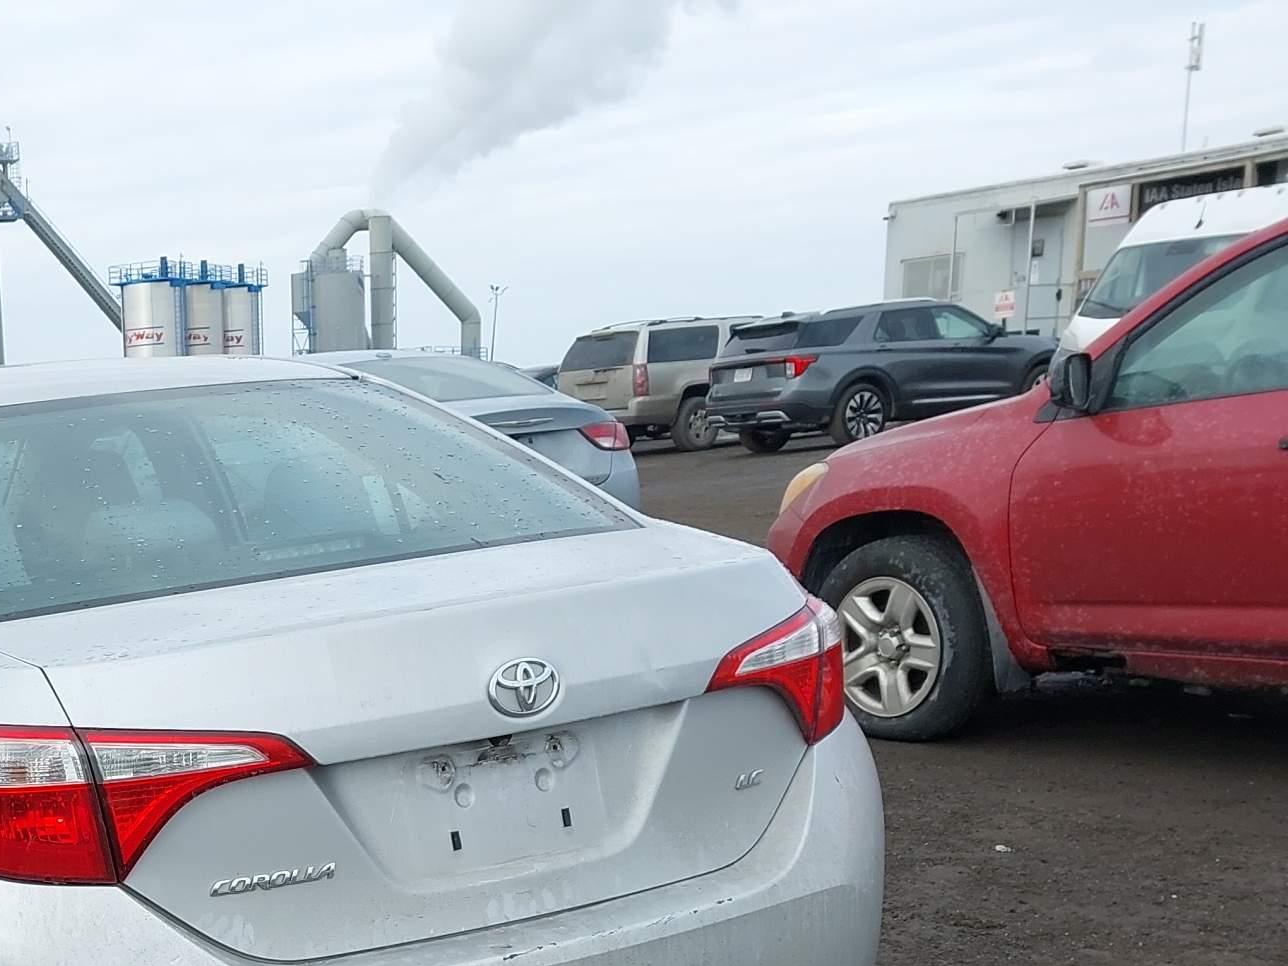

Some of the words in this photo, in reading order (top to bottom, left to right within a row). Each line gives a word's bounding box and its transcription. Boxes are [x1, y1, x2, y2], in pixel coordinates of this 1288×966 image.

[1216, 175, 1243, 191] Isla
[735, 769, 764, 790] LE
[210, 862, 336, 897] COROLLA
